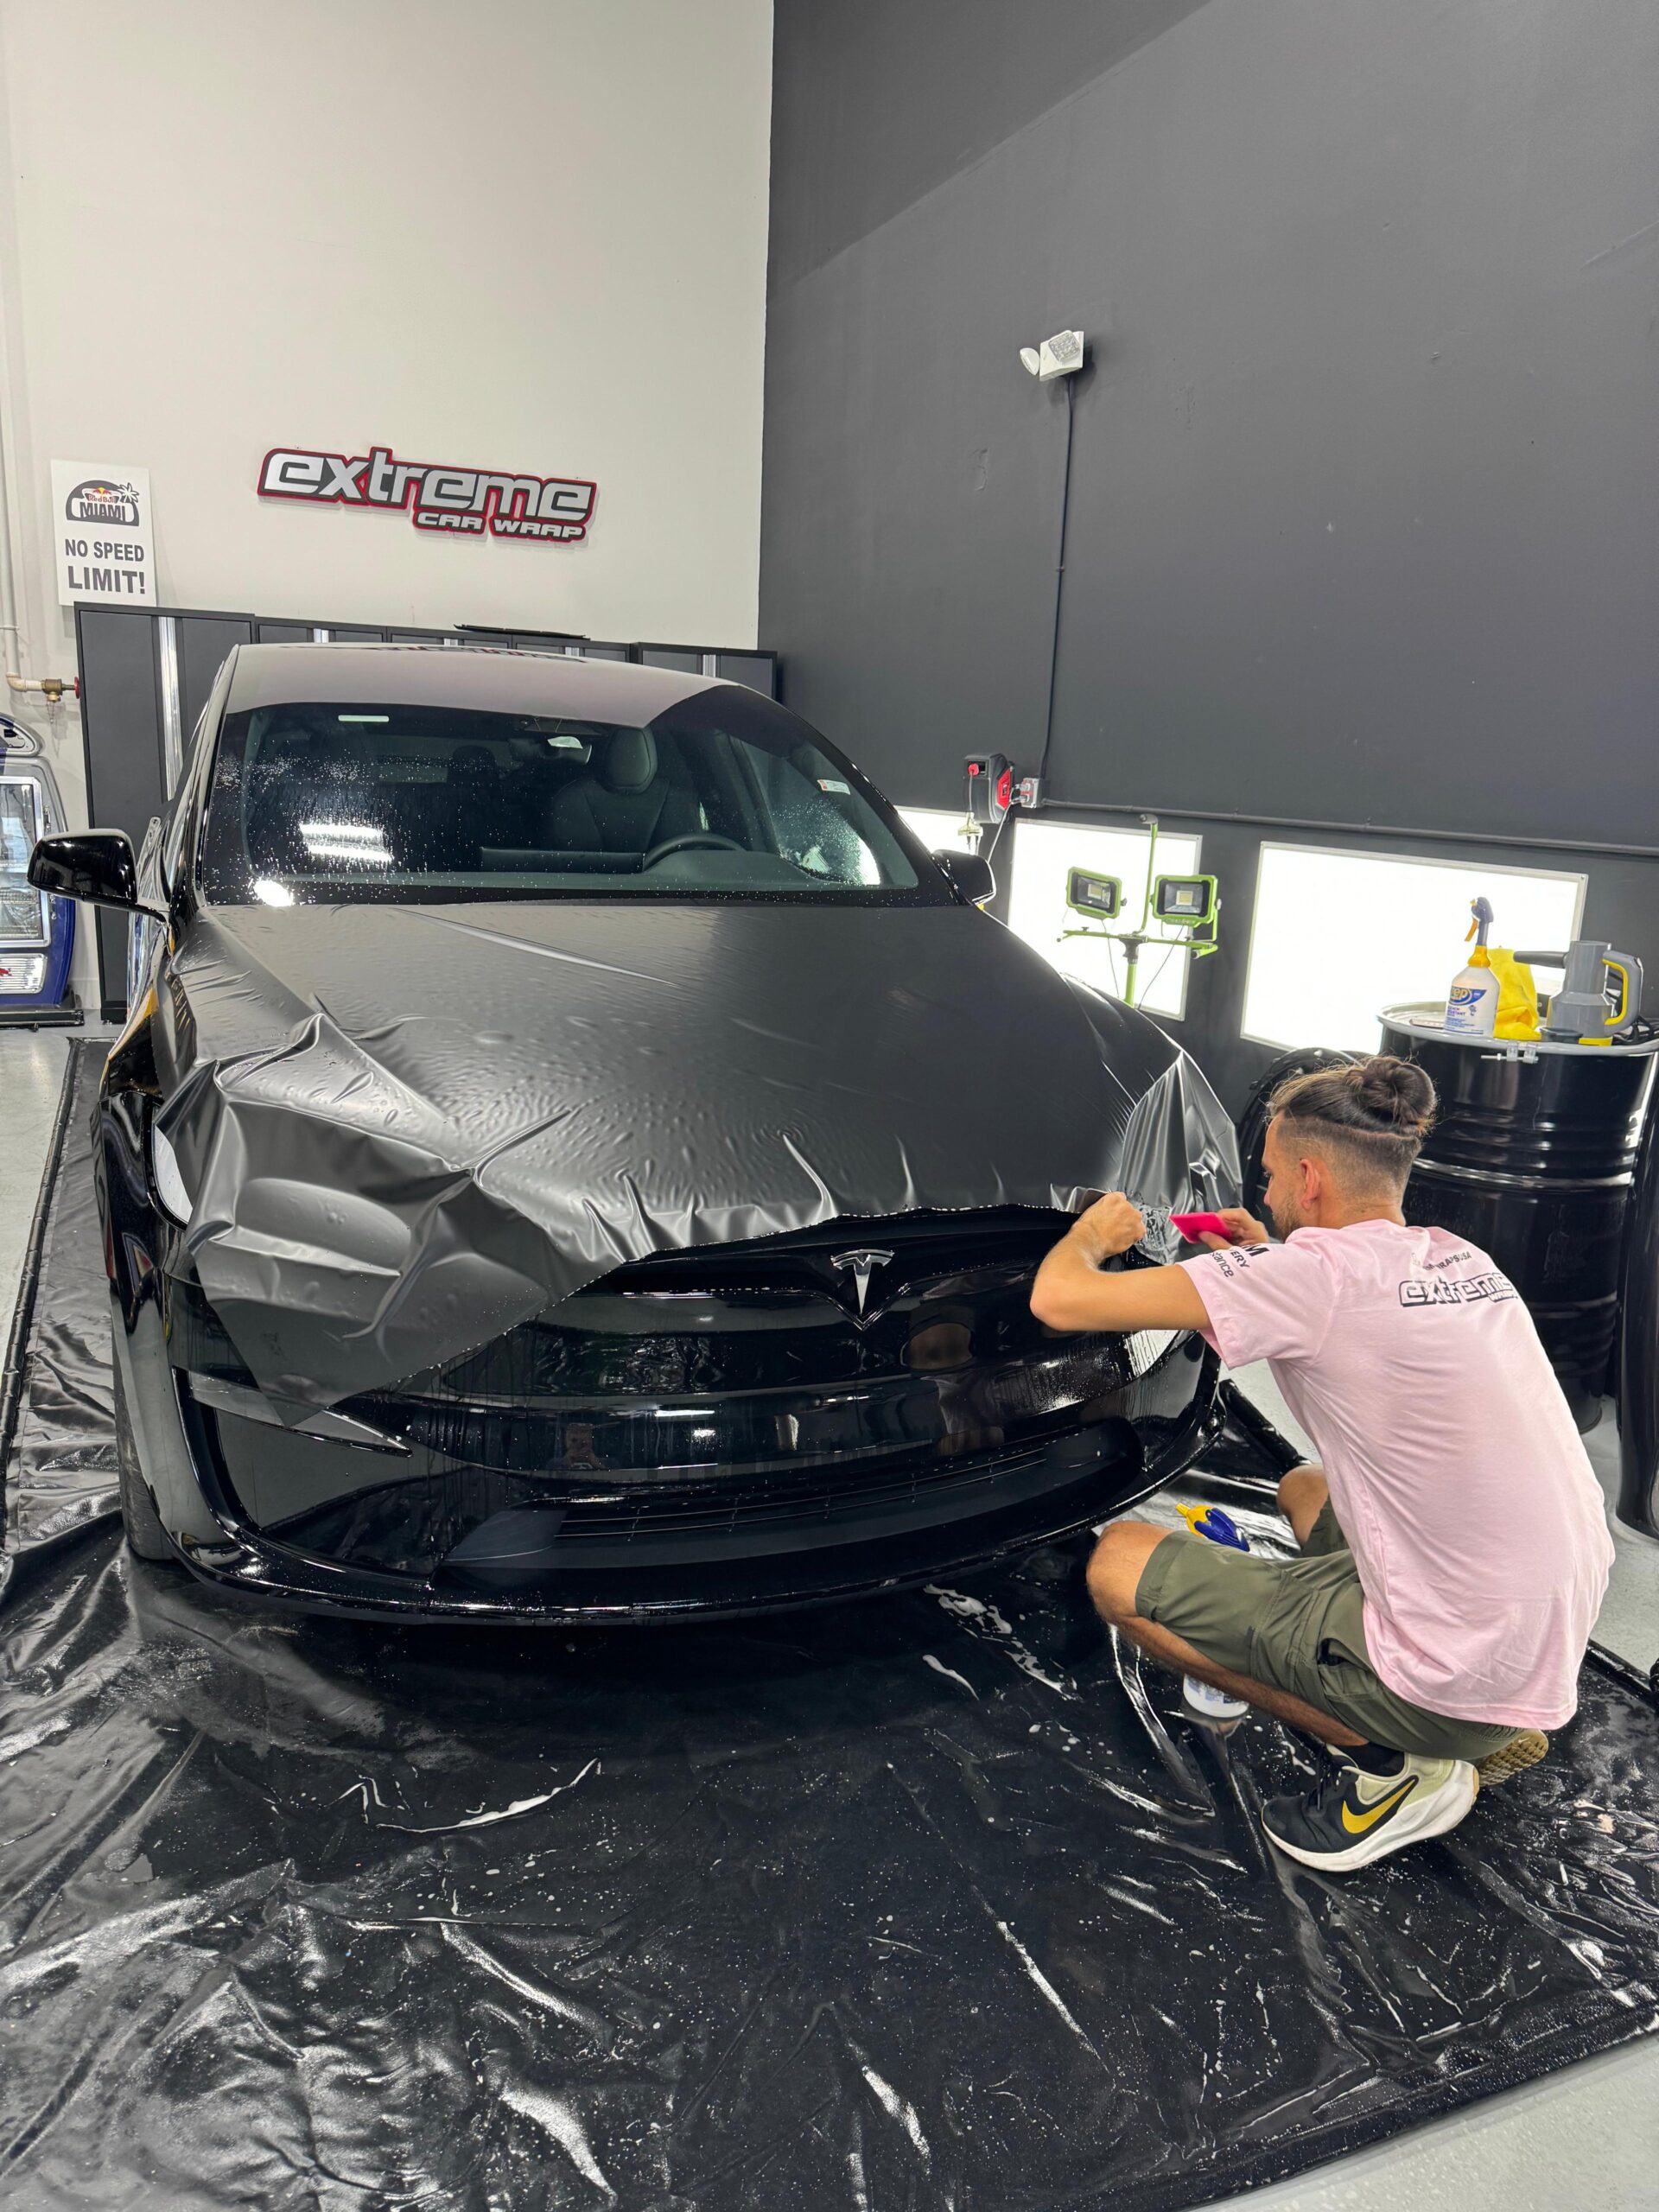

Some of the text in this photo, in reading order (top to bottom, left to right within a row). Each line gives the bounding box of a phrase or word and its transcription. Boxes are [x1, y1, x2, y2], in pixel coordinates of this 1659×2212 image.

[88, 493, 102, 502] Red
[261, 448, 595, 523] extreme
[79, 501, 125, 522] MIAMI
[416, 511, 583, 538] CAR WRAP
[65, 538, 144, 562] NO SPEED
[67, 565, 145, 594] LIMIT!
[1399, 1273, 1513, 1307] extreme
